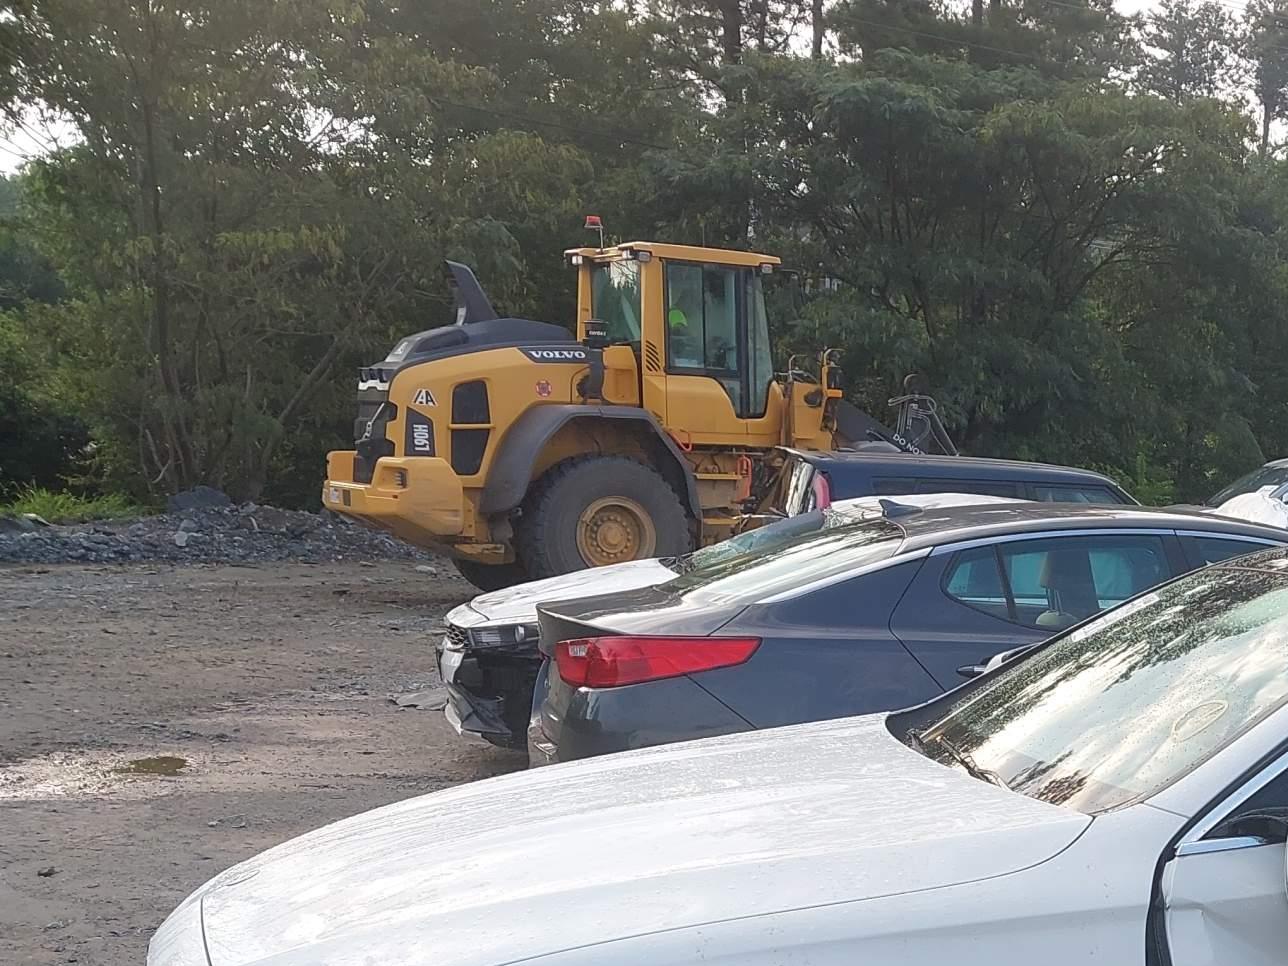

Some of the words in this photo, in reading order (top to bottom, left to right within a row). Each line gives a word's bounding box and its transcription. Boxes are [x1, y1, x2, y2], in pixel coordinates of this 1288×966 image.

[528, 350, 586, 359] VOLVO
[412, 423, 430, 451] L90H
[893, 433, 906, 446] DO
[906, 443, 926, 456] NO
